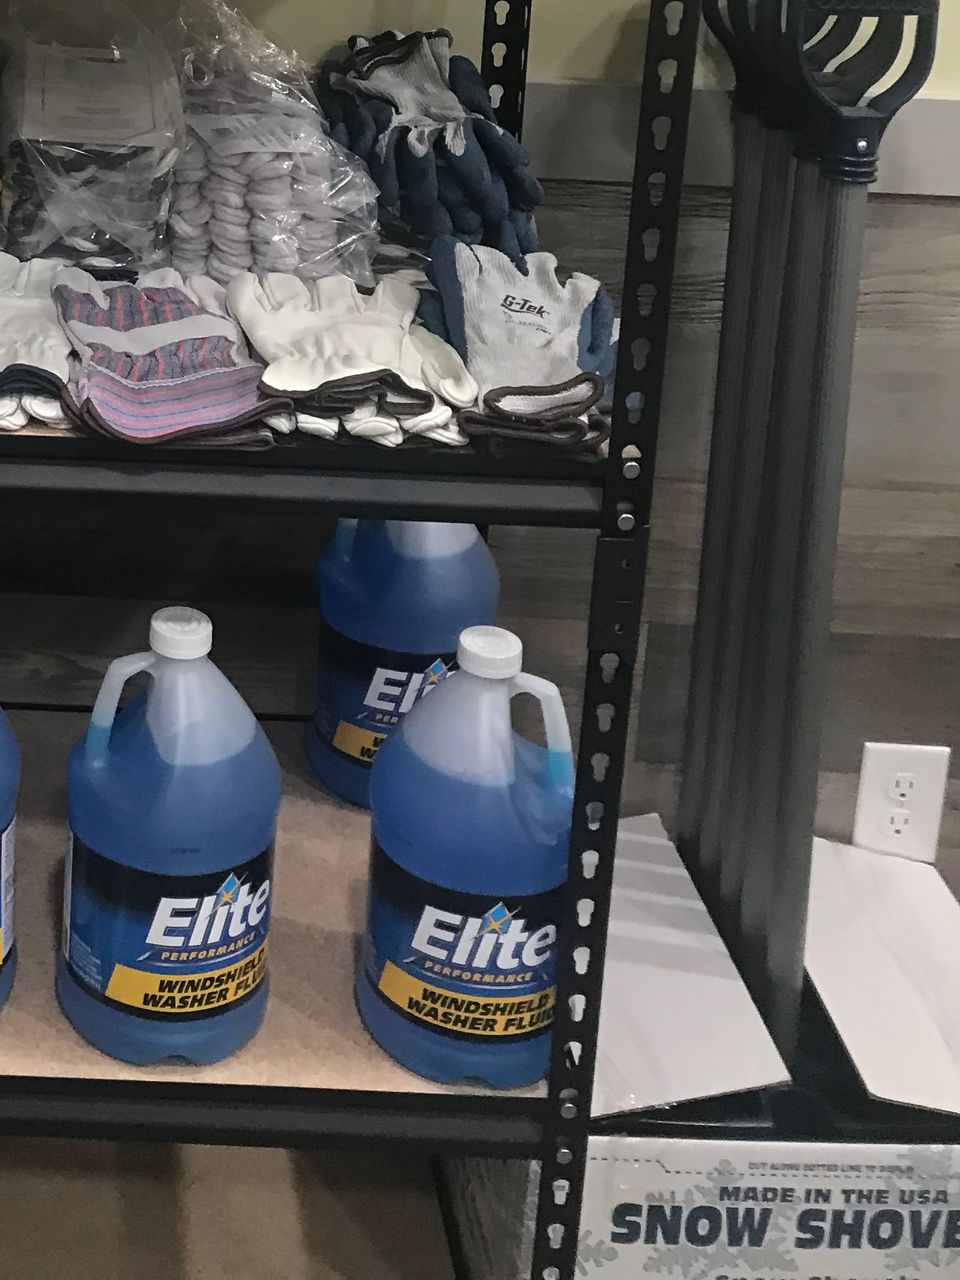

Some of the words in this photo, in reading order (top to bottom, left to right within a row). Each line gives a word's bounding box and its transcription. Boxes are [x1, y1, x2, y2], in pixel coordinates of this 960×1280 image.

[502, 294, 547, 319] G-Tek
[145, 878, 271, 947] Elite
[160, 932, 256, 961] PERFORMANCE
[410, 905, 558, 970] Elite
[424, 960, 534, 984] PERFORMANCE
[142, 987, 230, 1010] WASHER
[421, 987, 551, 1016] WINDSHIELD
[407, 997, 498, 1032] WASHER
[719, 1186, 796, 1203] MADE
[804, 1188, 832, 1204] IN
[842, 1189, 890, 1205] THE
[899, 1189, 949, 1205] USA
[610, 1202, 773, 1249] SNOW
